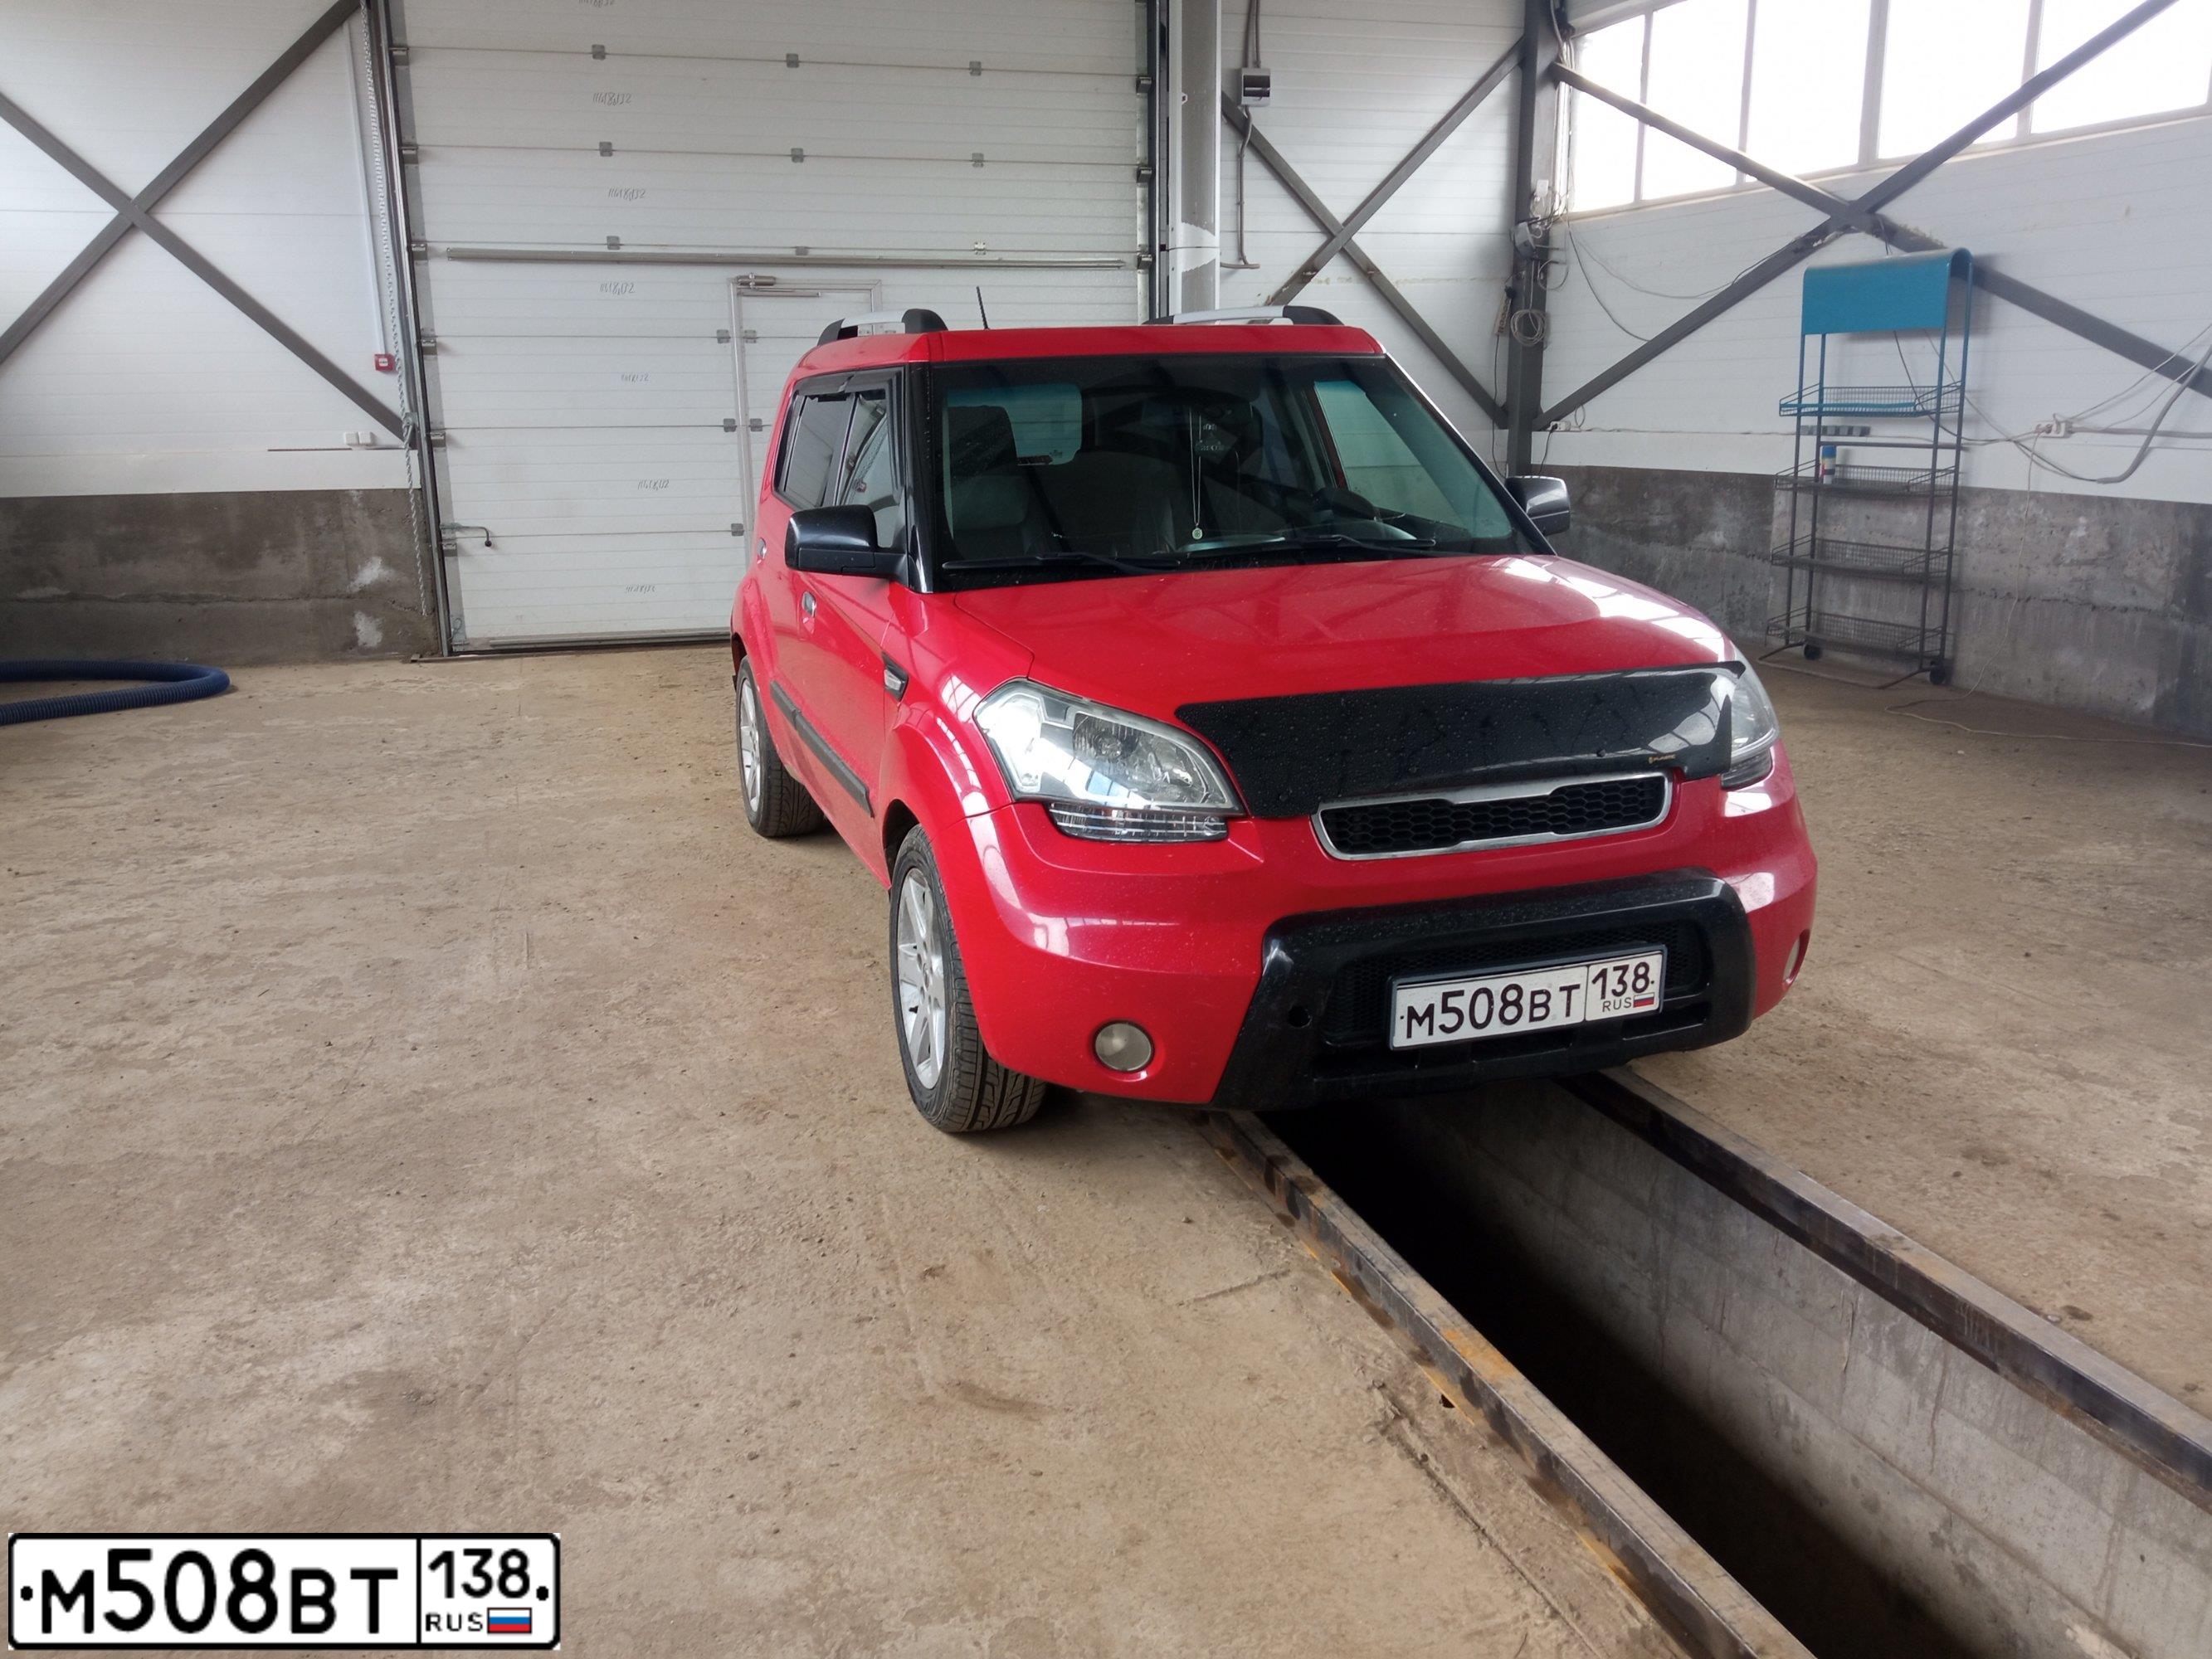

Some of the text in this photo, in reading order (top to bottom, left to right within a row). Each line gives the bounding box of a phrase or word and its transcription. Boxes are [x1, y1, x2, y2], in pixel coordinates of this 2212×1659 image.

[1591, 961, 1650, 1000] 138
[1406, 983, 1581, 1039] M508BT
[1602, 997, 1632, 1012] RUS
